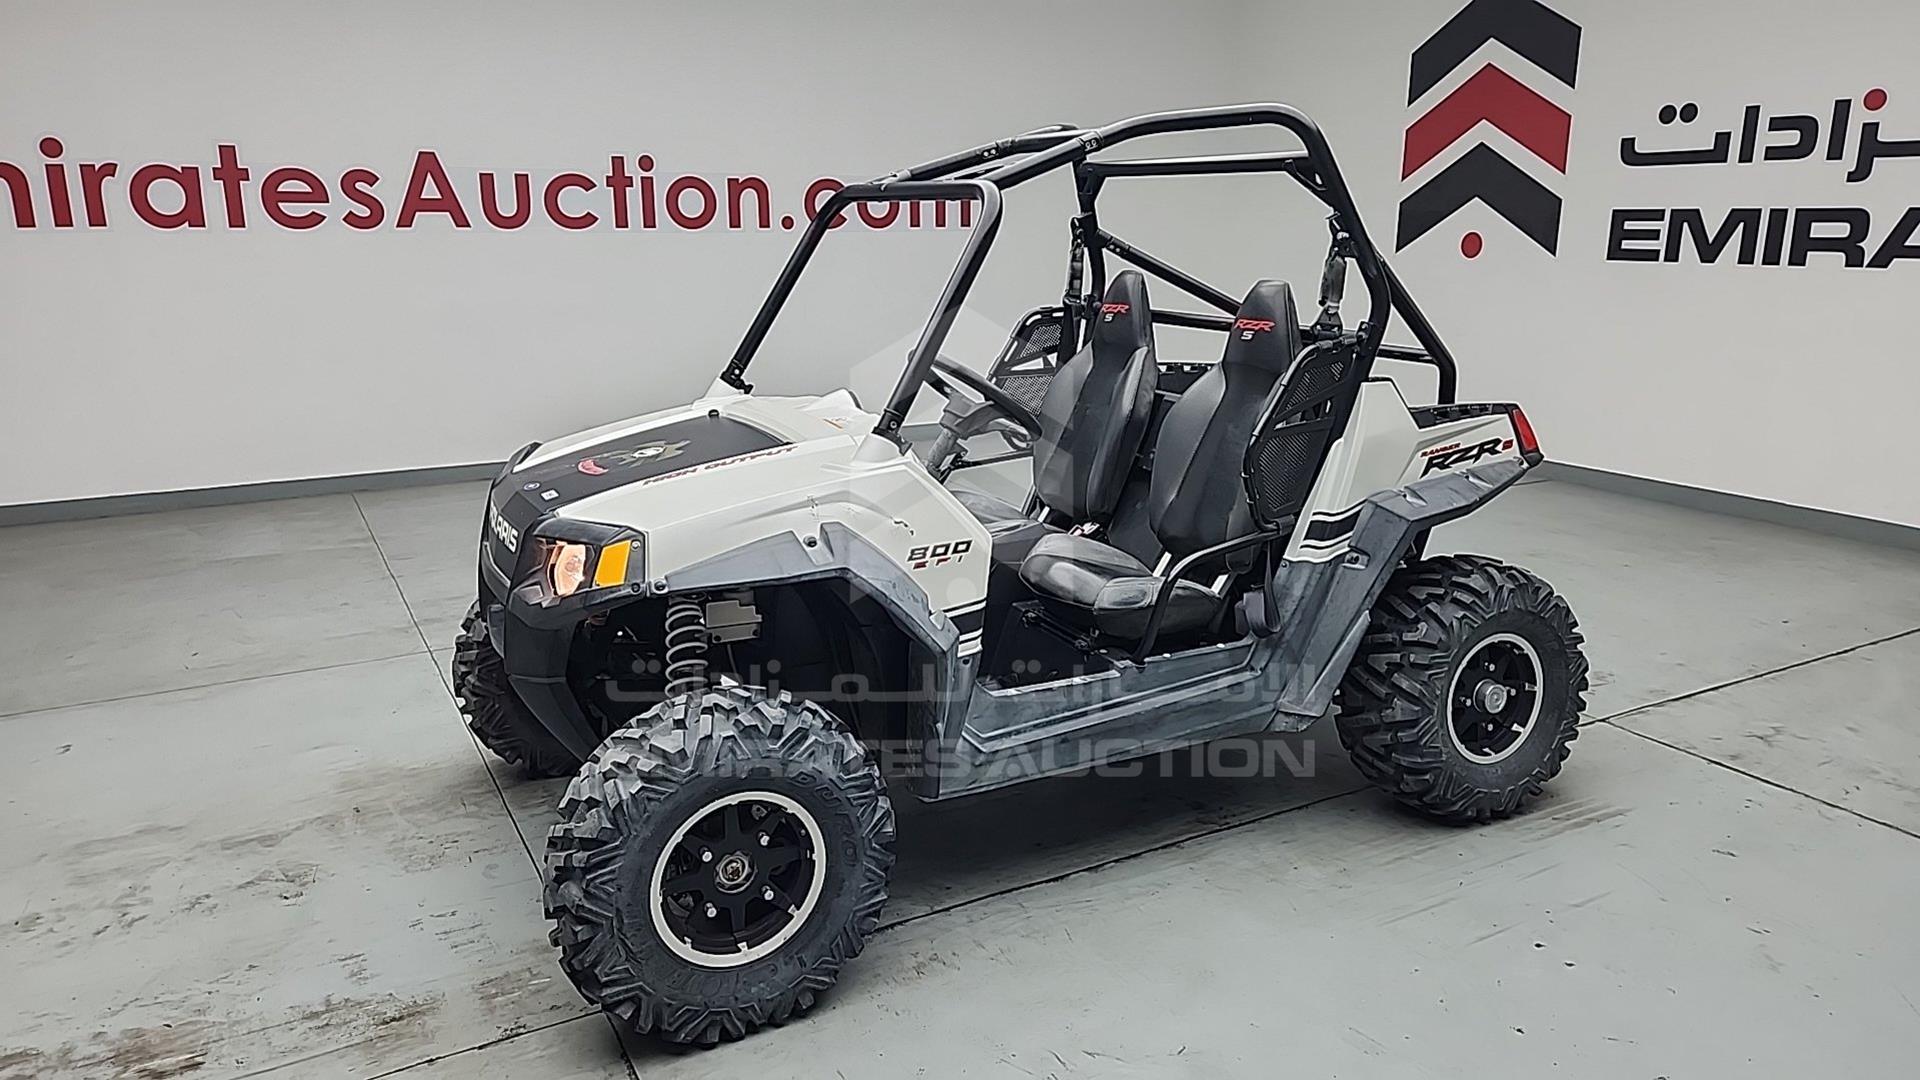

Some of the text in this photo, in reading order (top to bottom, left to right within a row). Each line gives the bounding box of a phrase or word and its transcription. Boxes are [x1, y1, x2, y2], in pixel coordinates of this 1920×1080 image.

[1101, 303, 1130, 314] RZR
[1104, 313, 1113, 322] S
[1233, 318, 1276, 332] RZR
[1241, 330, 1255, 340] S
[1419, 437, 1503, 480] RZR
[907, 539, 973, 562] 800
